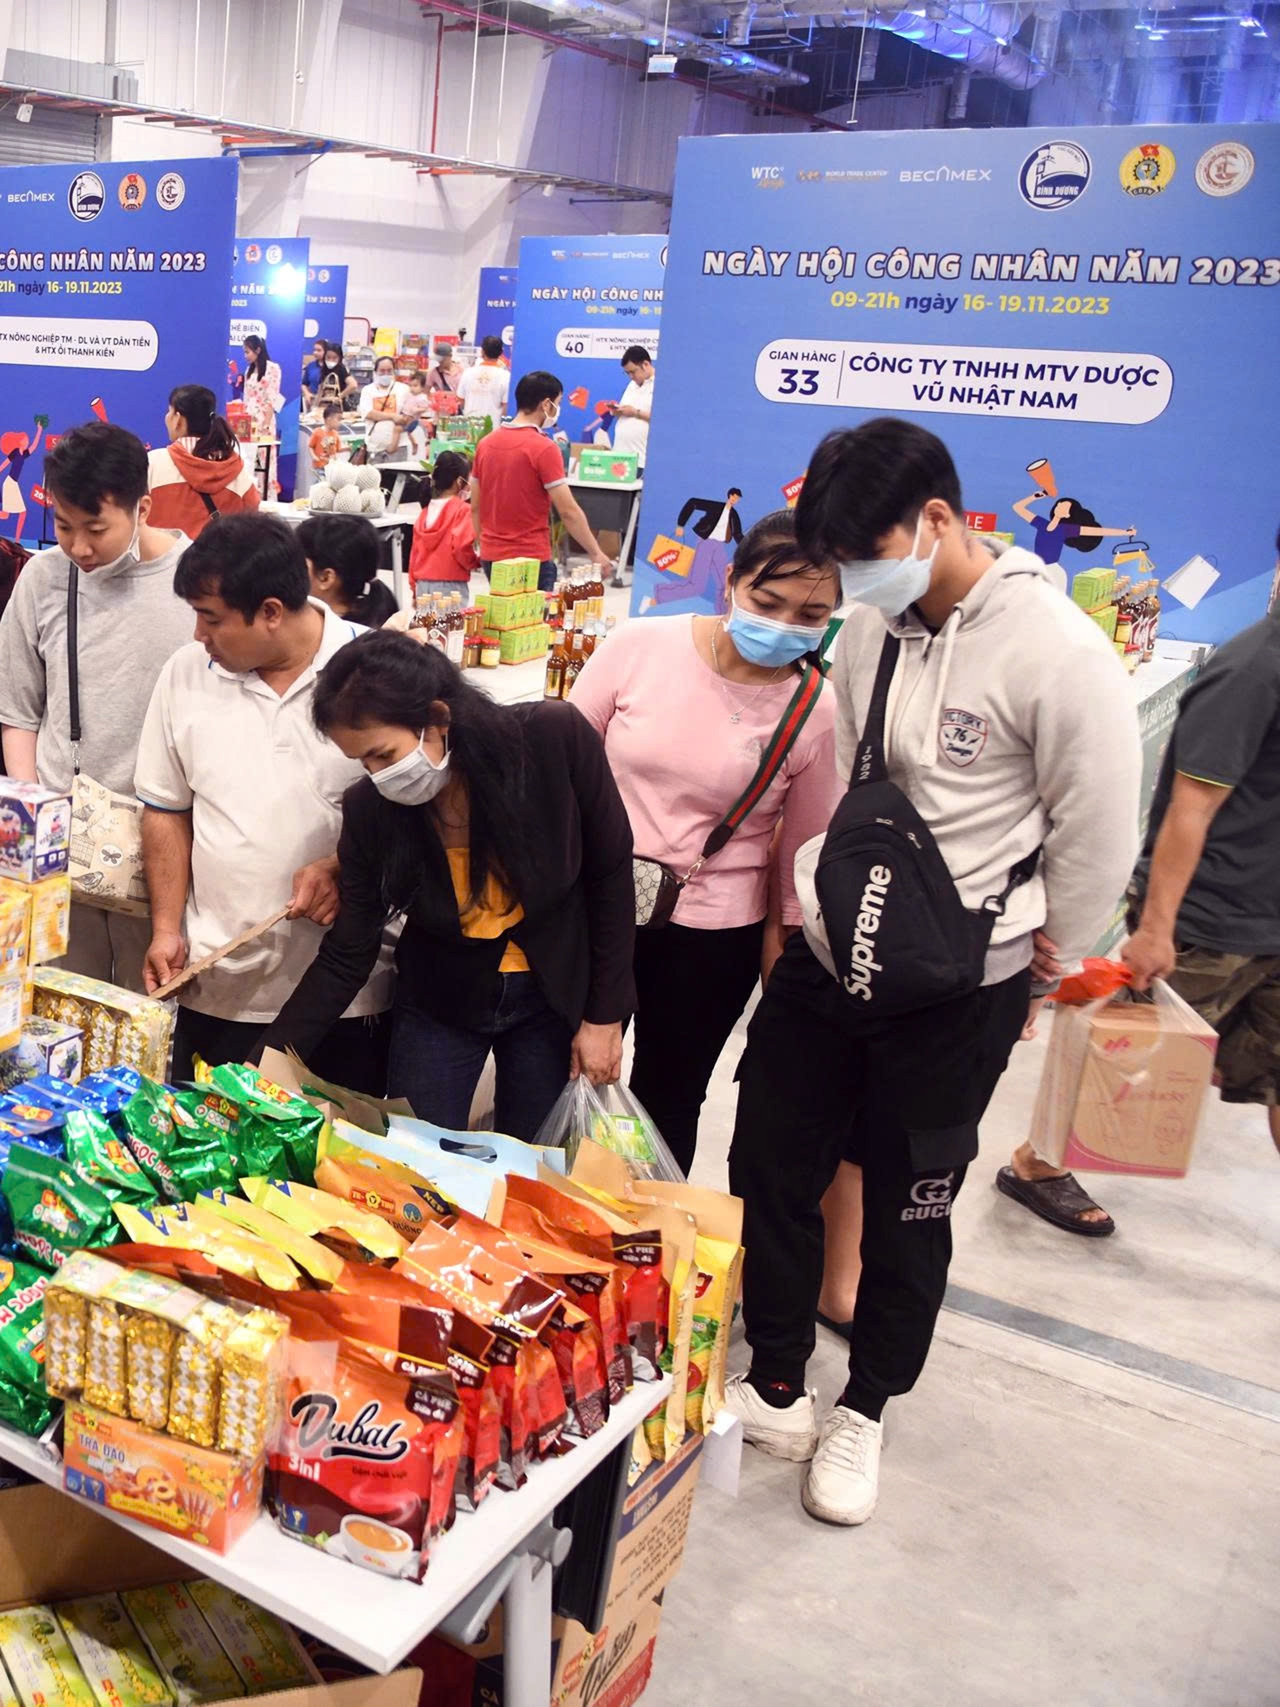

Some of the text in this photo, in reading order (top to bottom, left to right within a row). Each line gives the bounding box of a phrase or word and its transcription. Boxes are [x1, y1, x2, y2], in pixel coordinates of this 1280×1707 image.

[751, 167, 780, 179] WTC
[50, 249, 103, 271] NHÂN
[110, 248, 154, 271] NĂM
[160, 252, 206, 272] 2023
[703, 246, 1280, 286] NGÀY HỘI CÔNG NHÂN NĂM 2023
[17, 281, 45, 296] ngày
[47, 281, 63, 293] 16-
[65, 281, 122, 294] 19.11.2023
[240, 283, 265, 295] NĂM
[532, 286, 663, 303] NGÀY HỘI CÔNG NH
[319, 295, 337, 304] 2023
[487, 299, 510, 308] NGÀY
[830, 290, 1111, 316] 09-21h ngày 16- 19.11.2023
[616, 307, 637, 316] ngày
[9, 333, 31, 342] NÔNG
[32, 334, 60, 344] NGHIỆP
[78, 336, 88, 344] DL
[89, 335, 100, 345] VÀ
[102, 337, 112, 346] VT
[41, 347, 56, 355] HTX
[68, 348, 94, 357] THANH
[565, 342, 584, 353] 40
[768, 350, 837, 364] GIAN HÀNG
[848, 353, 1161, 390] CÔNG TY TNHH MTV DƯỢC
[777, 368, 820, 396] 33
[912, 381, 1078, 412] VŨ NHẬT NAM
[953, 727, 968, 742] 76
[843, 864, 893, 1001] Supreme
[288, 1452, 320, 1481] 3in1
